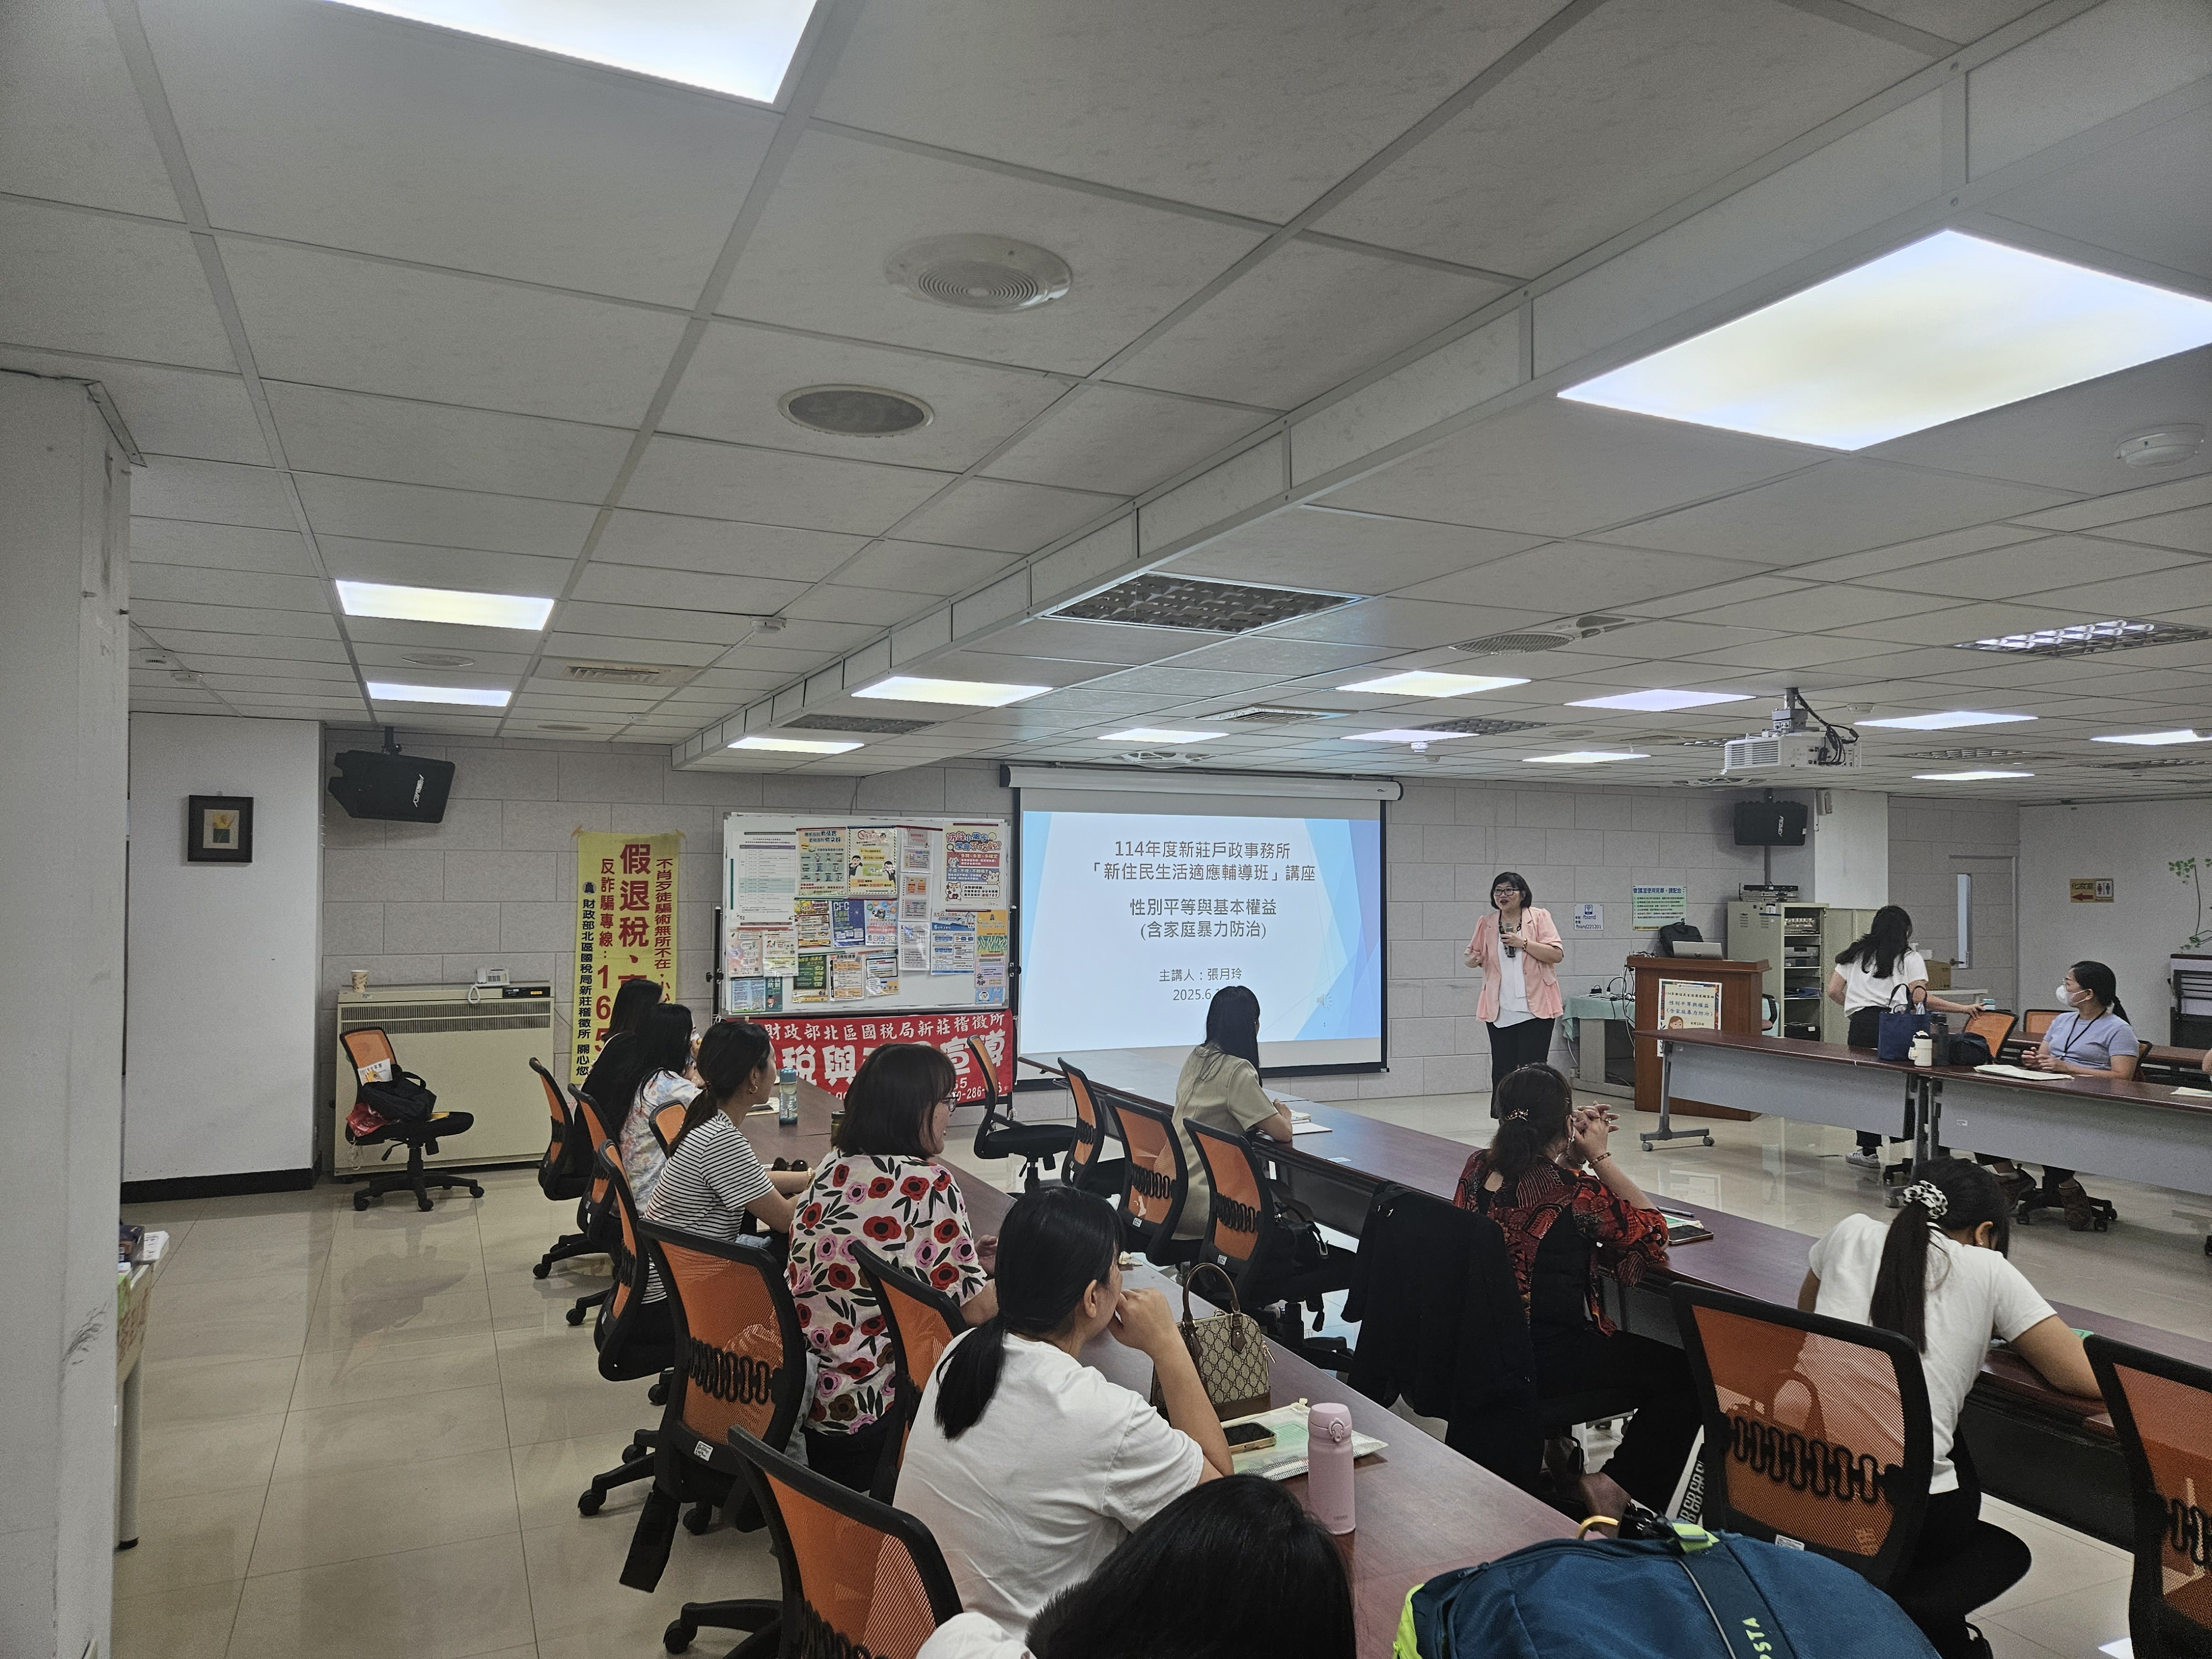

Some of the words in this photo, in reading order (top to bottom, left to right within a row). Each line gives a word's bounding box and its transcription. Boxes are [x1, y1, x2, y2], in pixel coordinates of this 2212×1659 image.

[1114, 840, 1290, 859] 114年度新莊戶政事務所
[1093, 862, 1316, 882] 「新住民生活適應輔導班」講座
[618, 844, 651, 986] 假退稅、
[833, 901, 849, 911] CFC
[1130, 898, 1277, 916] 性別平等與基本權益
[1140, 920, 1267, 939] (含家庭暴力防治)
[1159, 967, 1243, 983] 主講人：張月玲
[1173, 988, 1220, 1001] 2025.6
[765, 1013, 1005, 1041] 財政部北區國稅局新莊稽徵所
[576, 1044, 590, 1076] 關心您
